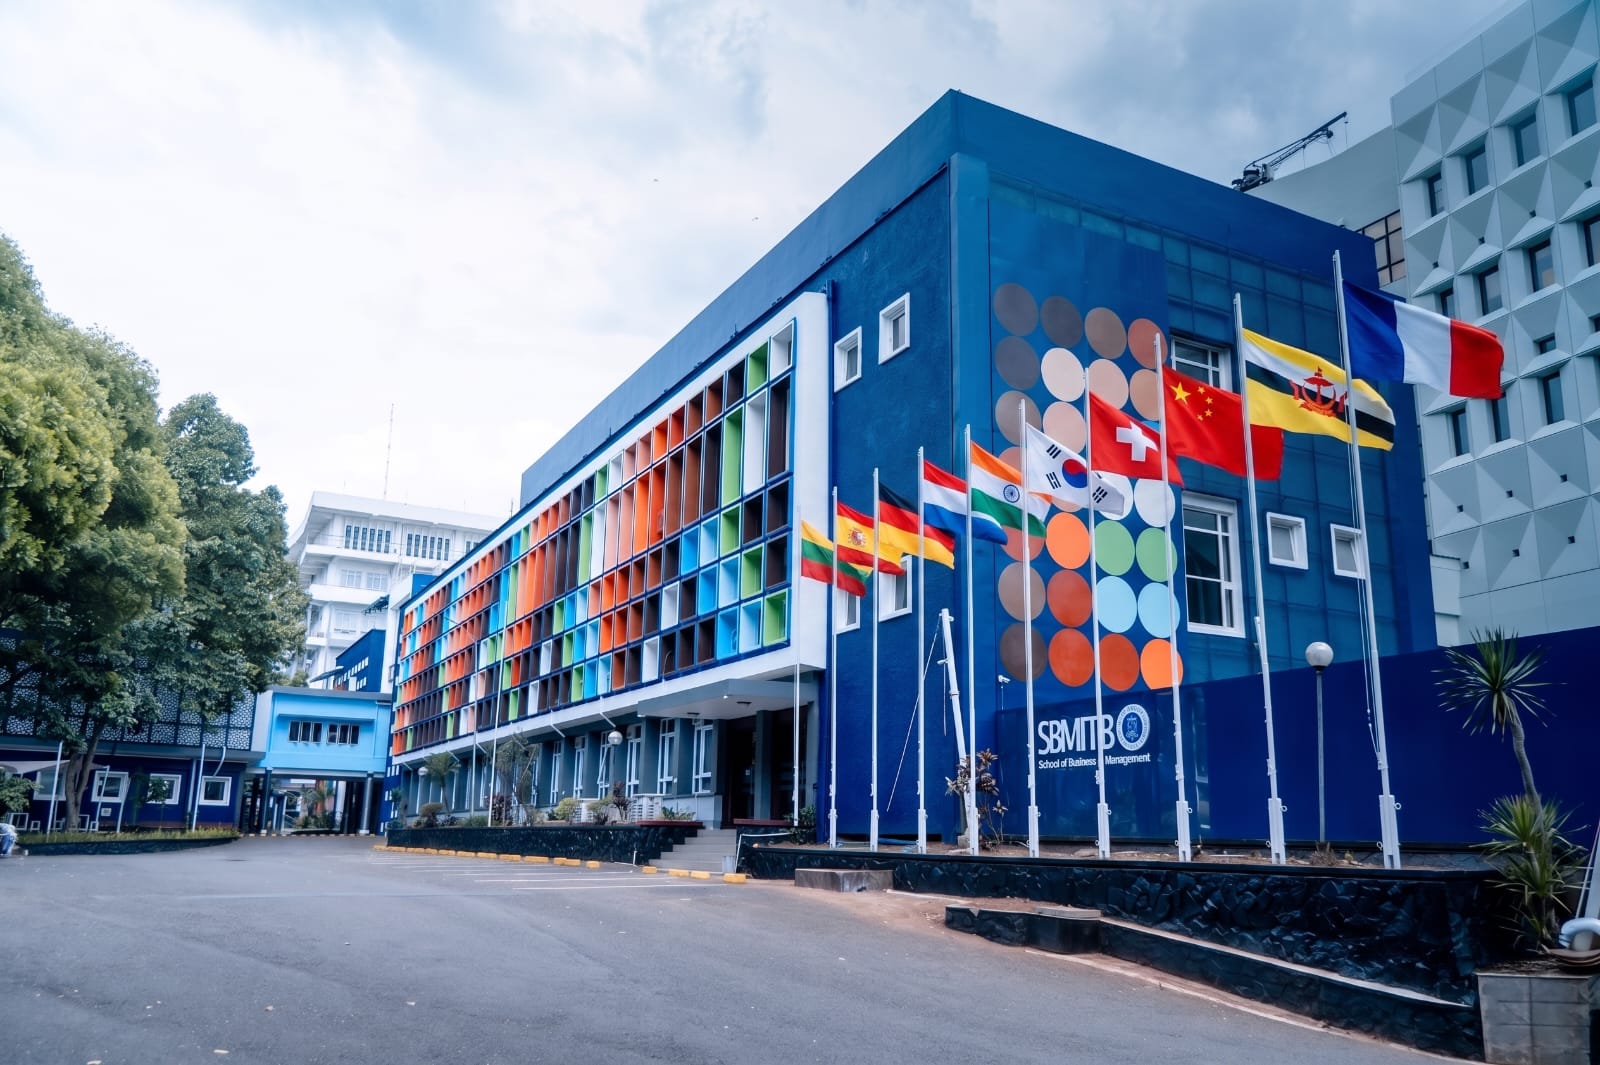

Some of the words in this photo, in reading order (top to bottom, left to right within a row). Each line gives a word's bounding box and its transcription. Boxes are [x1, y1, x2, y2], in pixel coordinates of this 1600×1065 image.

[1038, 759, 1060, 769] School
[1060, 758, 1067, 768] of
[1068, 757, 1097, 767] Business
[1104, 752, 1151, 766] Management
